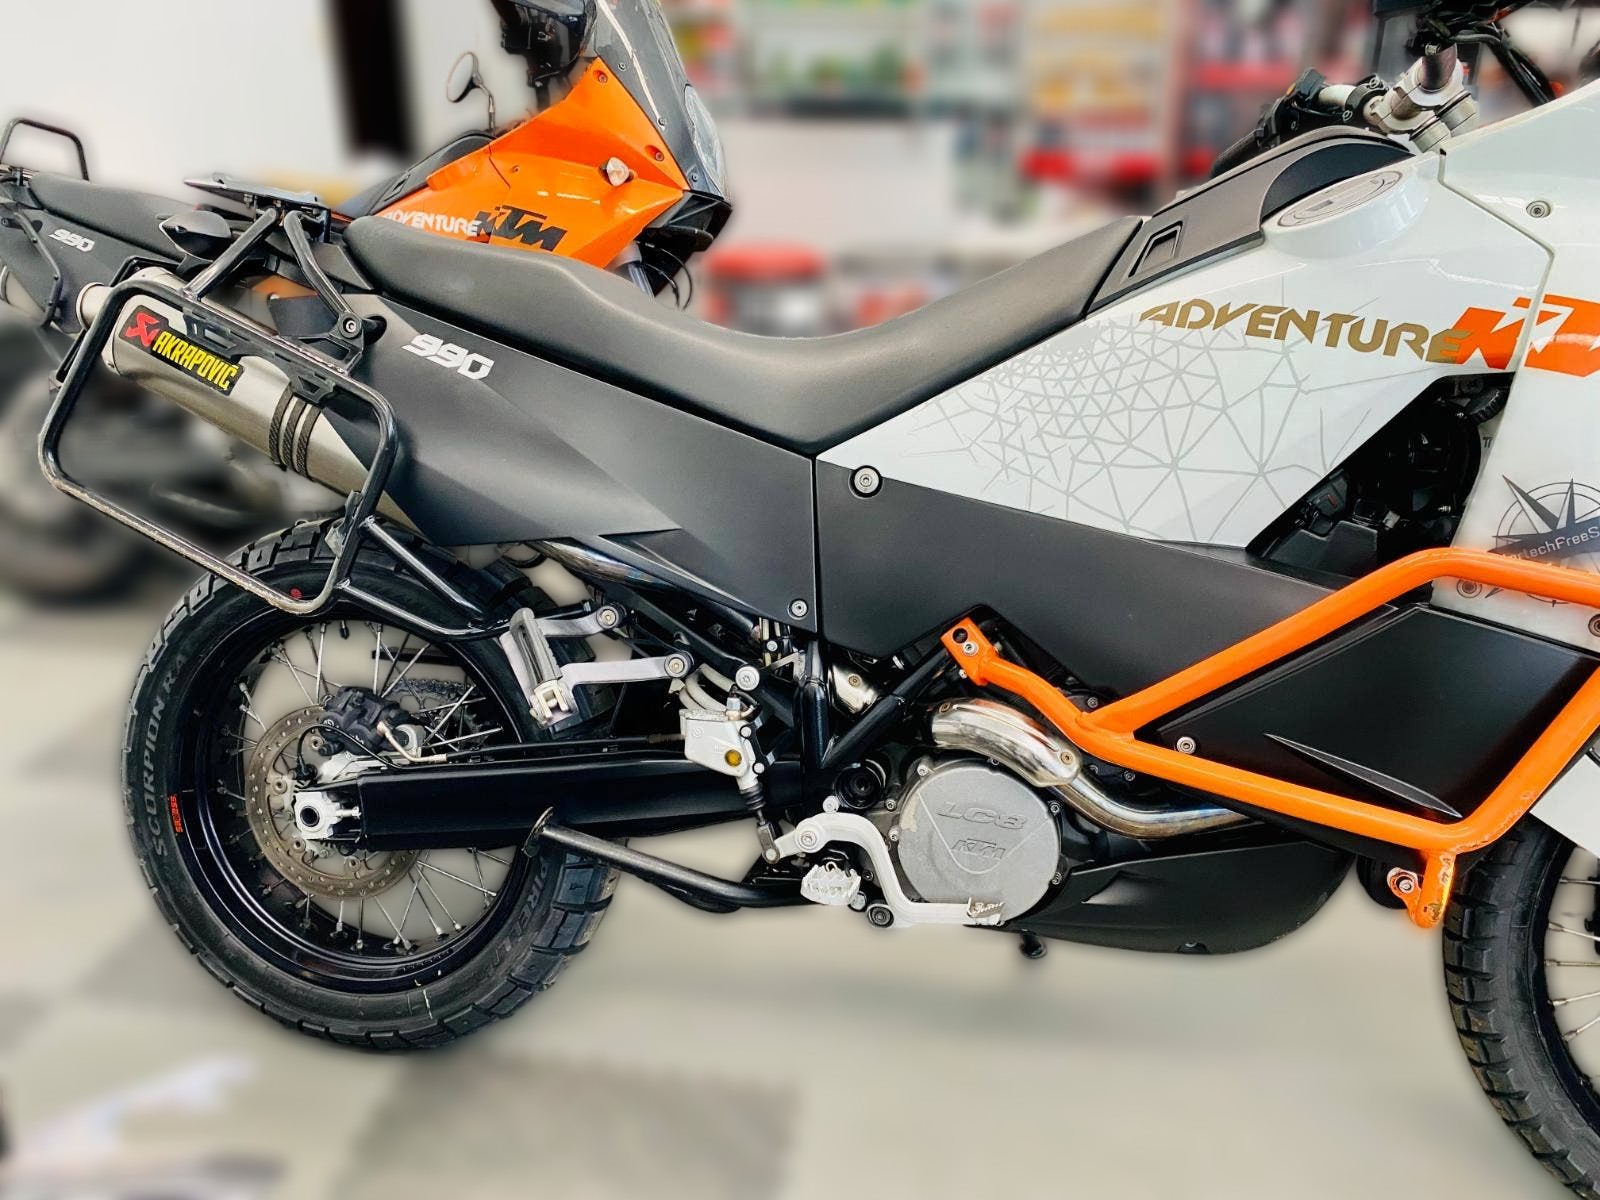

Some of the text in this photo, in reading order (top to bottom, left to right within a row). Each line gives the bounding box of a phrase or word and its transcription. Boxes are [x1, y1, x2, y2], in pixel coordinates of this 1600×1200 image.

[48, 228, 96, 253] 990
[384, 205, 567, 252] ADVENTURE KTM
[401, 334, 495, 380] 990
[1139, 294, 1600, 378] ADVENTURE KT
[143, 696, 169, 857] SCORPION
[936, 801, 1028, 830] LC8
